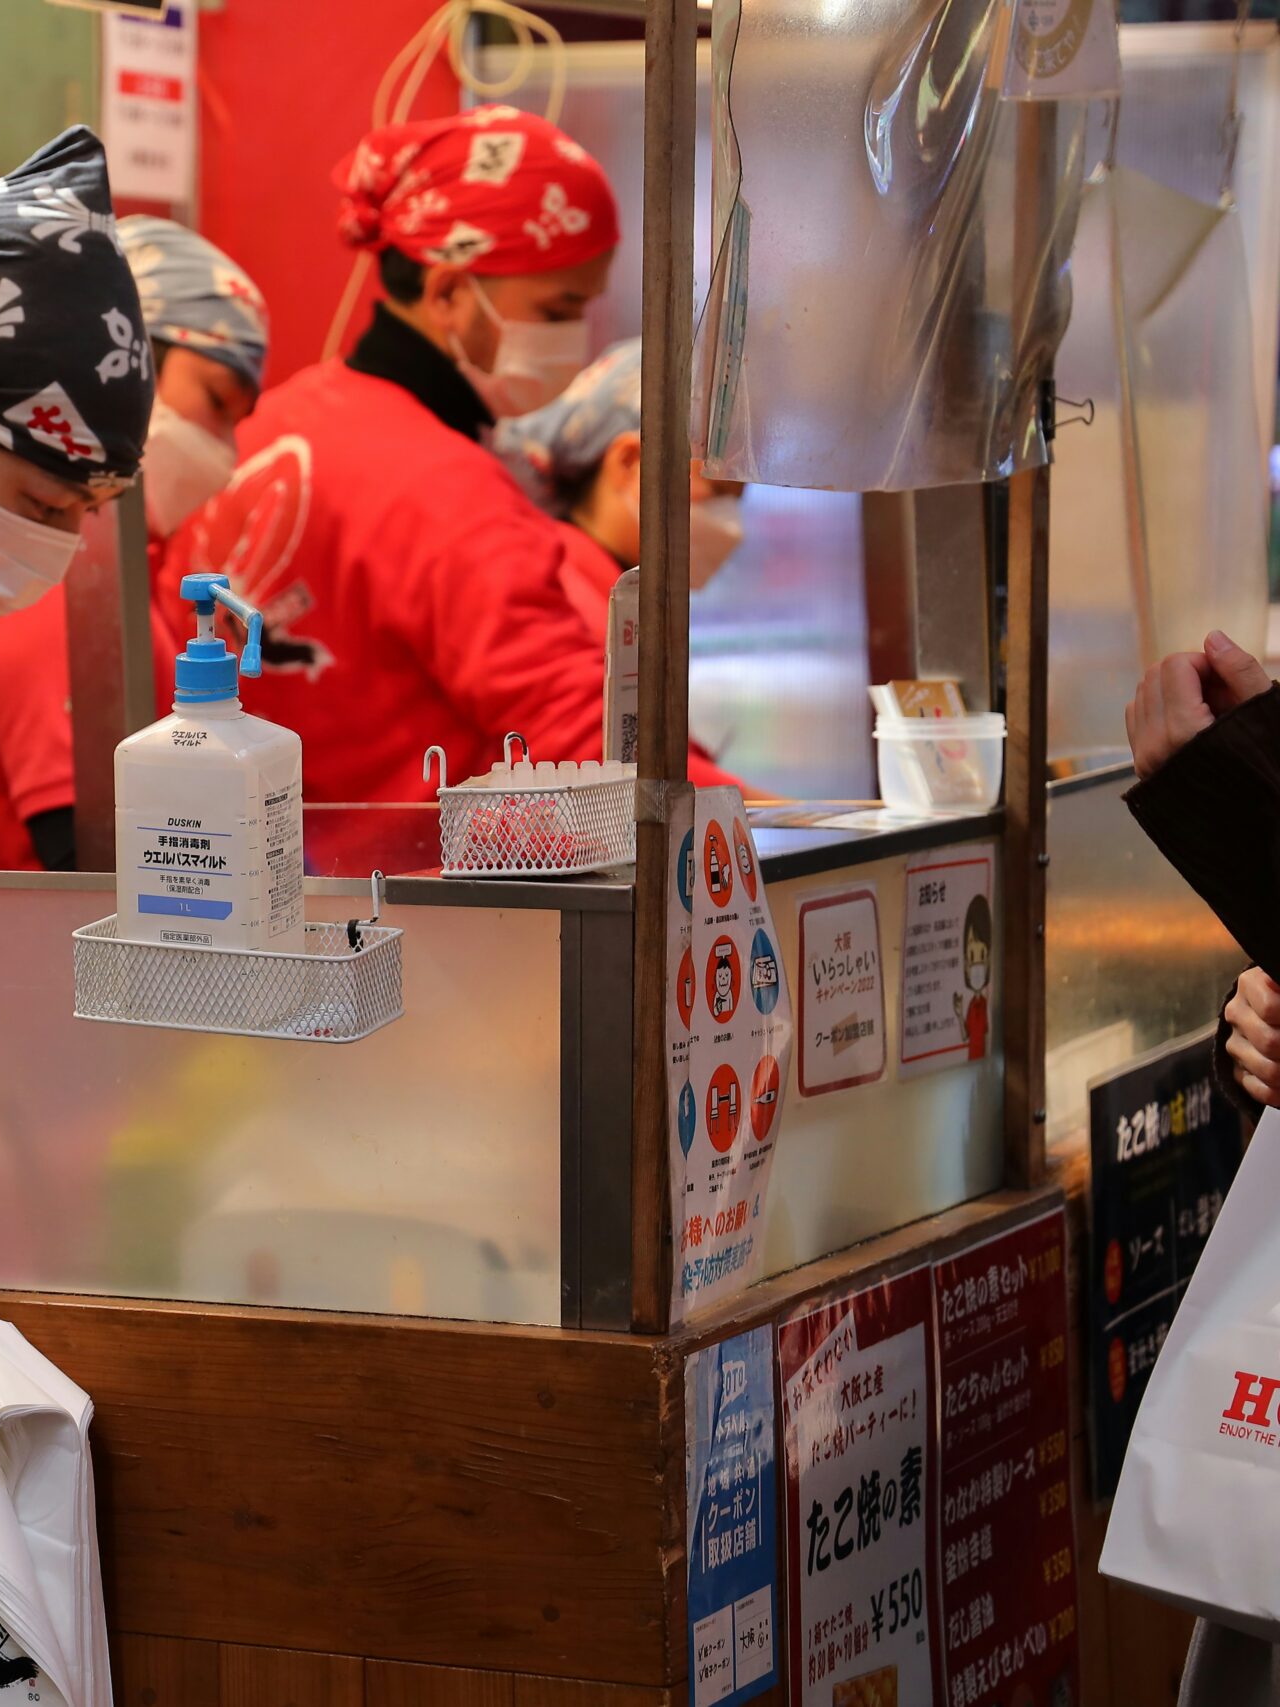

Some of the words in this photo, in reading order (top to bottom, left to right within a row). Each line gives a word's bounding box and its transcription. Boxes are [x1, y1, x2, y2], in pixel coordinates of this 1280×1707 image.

[171, 730, 208, 740] ウエルパス
[173, 739, 202, 747] マイルド
[167, 817, 202, 829] DUSKIN
[158, 835, 211, 850] 手指消毒剤
[143, 850, 227, 870] ウエルパスマイルド
[159, 874, 211, 887] 手指を素早く消毒
[918, 879, 947, 907] お知らせ
[162, 932, 210, 944] 指定医薬部外品
[834, 931, 852, 954] 大阪
[813, 949, 876, 987] いらっしゃい
[816, 974, 875, 1005] キャンペーン2022
[1128, 1224, 1165, 1273] ソース
[941, 1253, 1029, 1325] たこ焼の素セット
[793, 1327, 853, 1411] お家でわなか
[945, 1345, 1029, 1419] たこちゃんセット
[841, 1365, 884, 1411] 大阪土産
[1219, 1422, 1253, 1440] ENJOY
[1254, 1430, 1277, 1446] THE
[944, 1447, 1036, 1527] わなか特製ソース
[708, 1488, 756, 1533] クーポン
[807, 1446, 922, 1577] たこ焼の素
[708, 1517, 757, 1569] 取扱店舗
[870, 1567, 923, 1643] ¥550
[948, 1592, 995, 1651] だし醤油
[740, 1627, 756, 1654] 大阪
